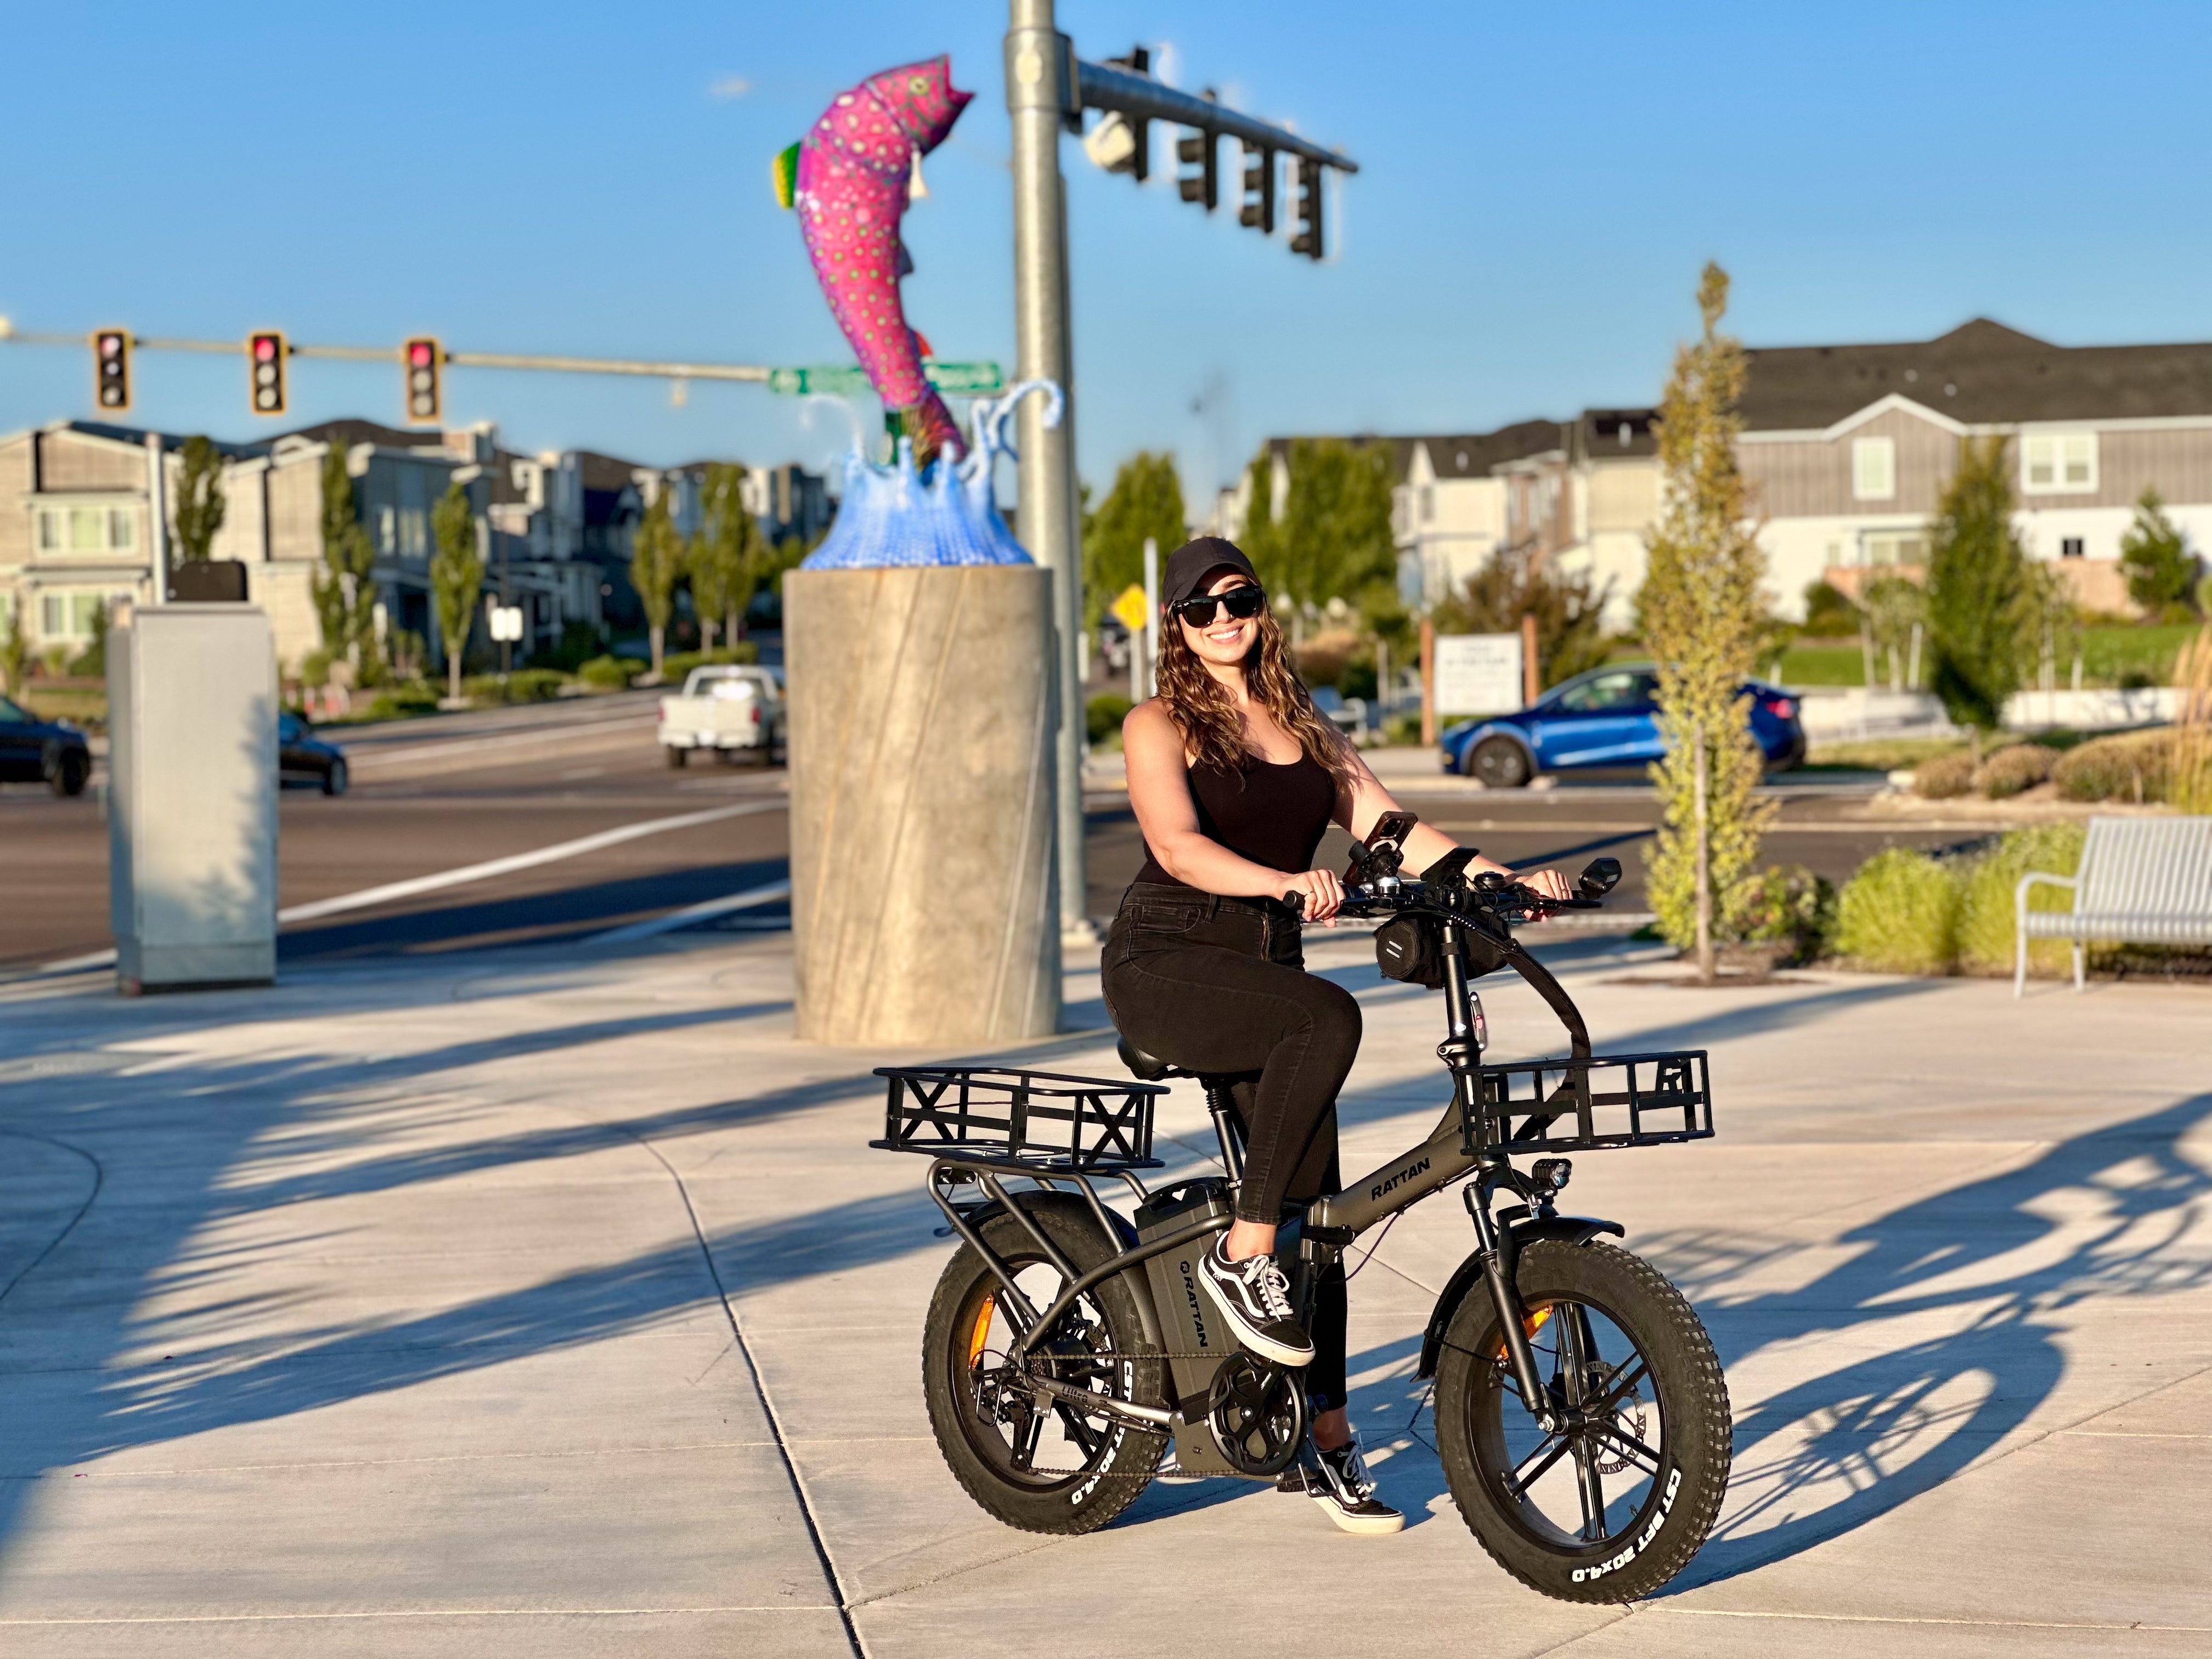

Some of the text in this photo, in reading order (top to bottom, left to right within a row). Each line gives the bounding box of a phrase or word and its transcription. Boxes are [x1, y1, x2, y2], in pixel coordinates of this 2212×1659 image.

[1371, 1157, 1431, 1202] RATTAN
[1183, 1276, 1208, 1347] RATTAN
[1062, 1385, 1088, 1403] Ultra
[1124, 1360, 1133, 1402] CST
[1662, 1468, 1681, 1513] CST
[1638, 1510, 1665, 1552] BFT
